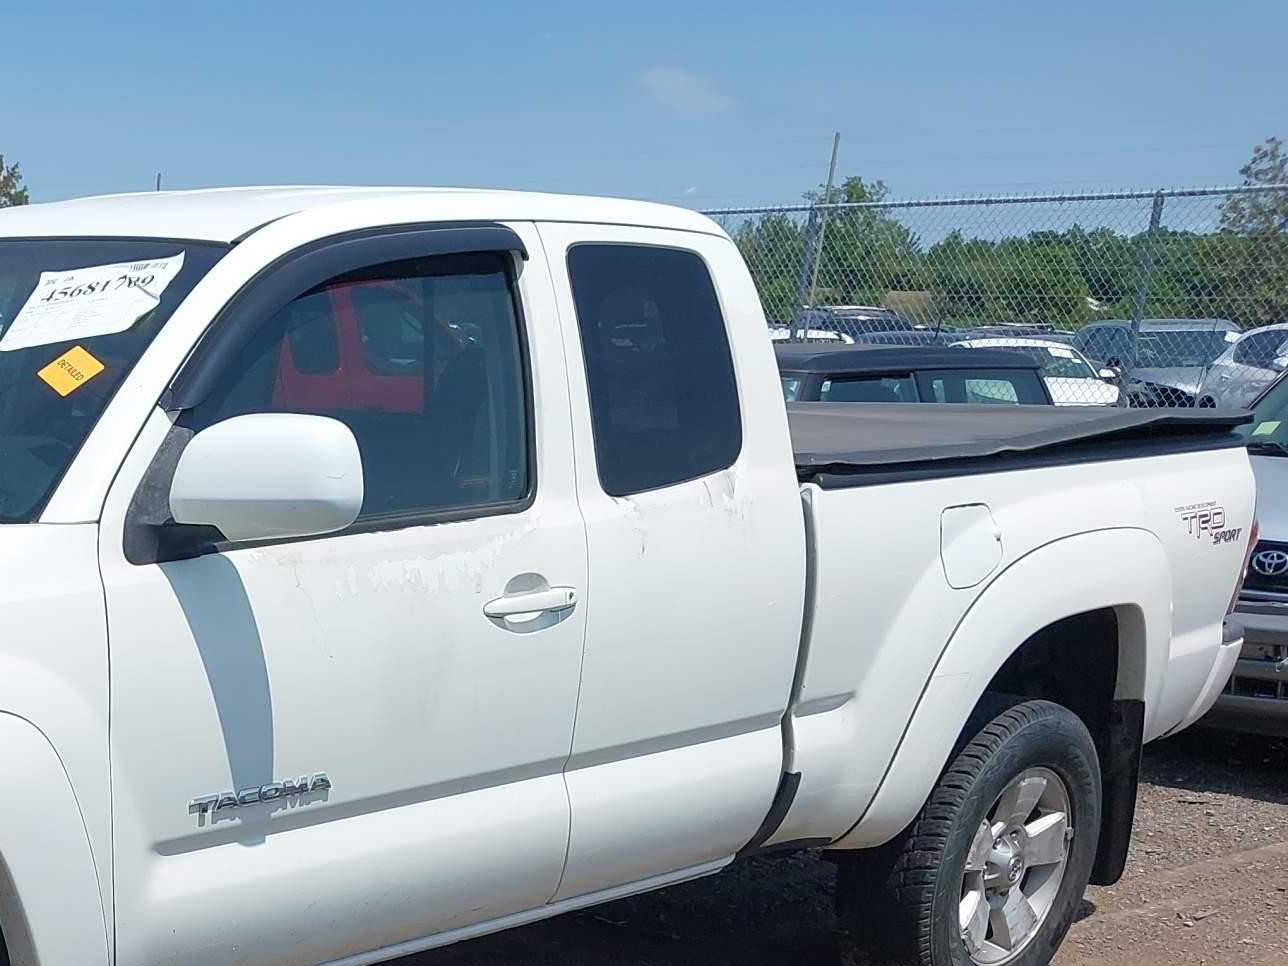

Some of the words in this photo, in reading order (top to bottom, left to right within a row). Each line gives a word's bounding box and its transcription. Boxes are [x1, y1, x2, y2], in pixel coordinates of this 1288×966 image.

[56, 358, 85, 381] DETAILED
[1180, 506, 1226, 539] TRD
[1212, 527, 1243, 546] SPORT
[188, 772, 332, 828] TACOMA
